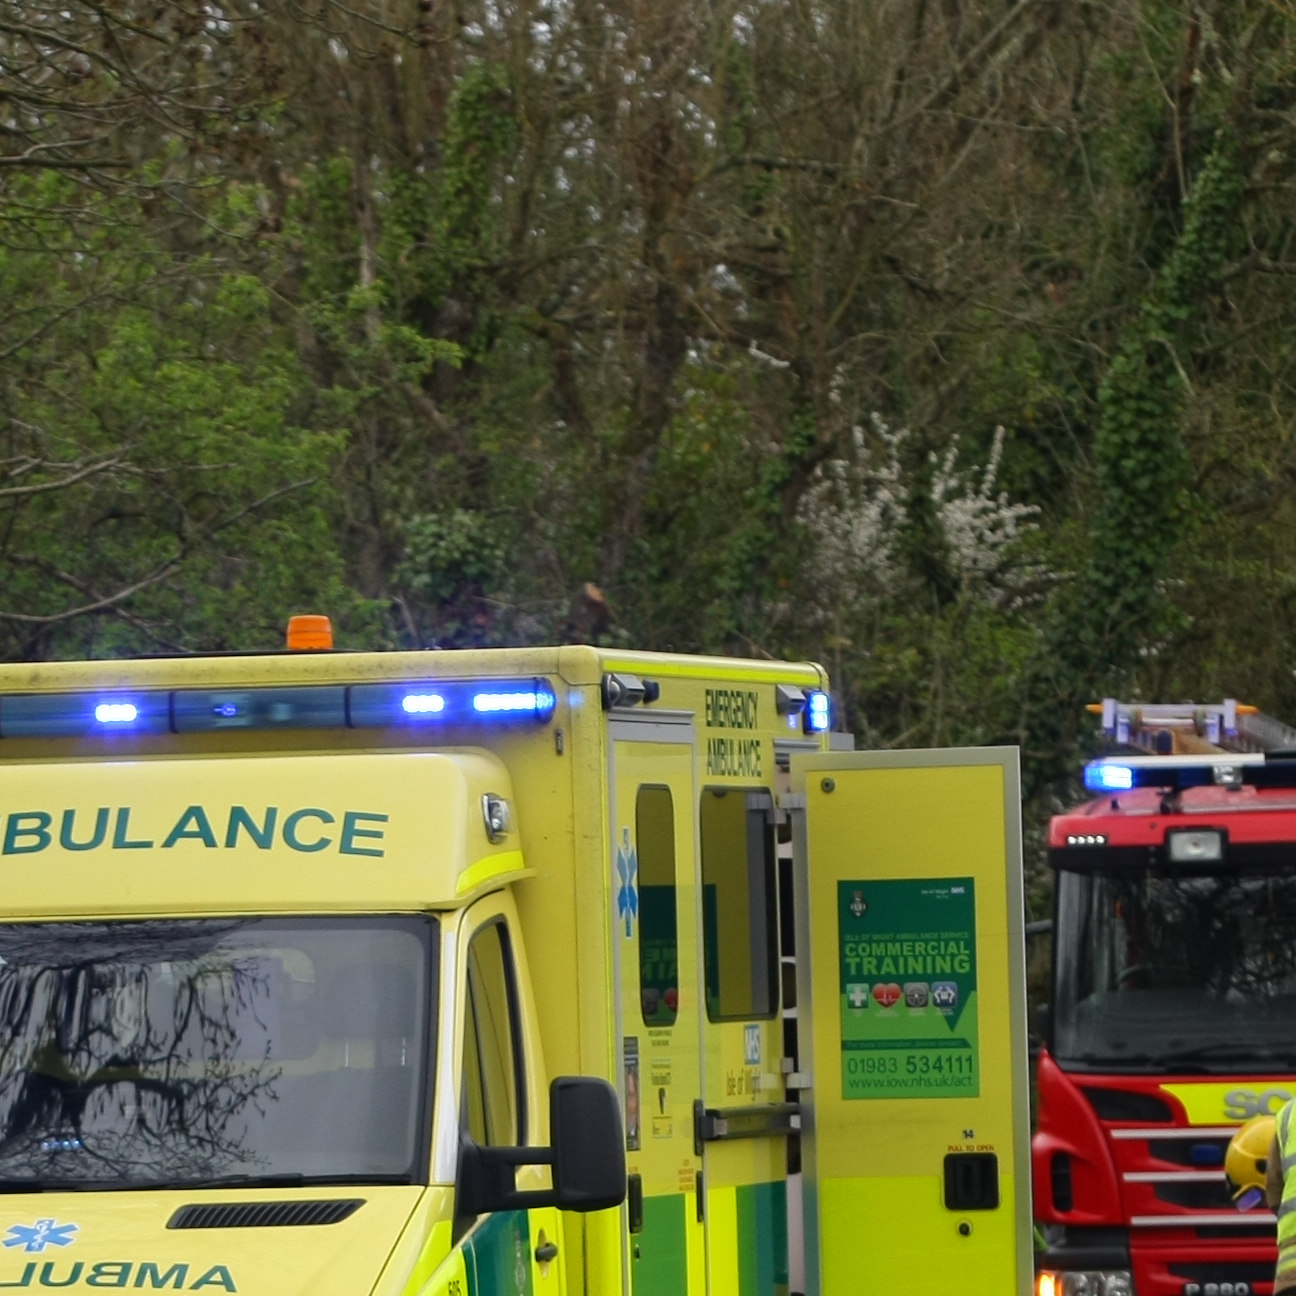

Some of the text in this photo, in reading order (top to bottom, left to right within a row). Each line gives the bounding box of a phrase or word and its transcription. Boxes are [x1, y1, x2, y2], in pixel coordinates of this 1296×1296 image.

[706, 689, 758, 730] EMERGENCY
[707, 738, 761, 777] AMBULANCE
[845, 941, 970, 956] COMMERCIAL
[845, 955, 971, 975] TRAINING
[847, 1055, 973, 1074] 01983 534111
